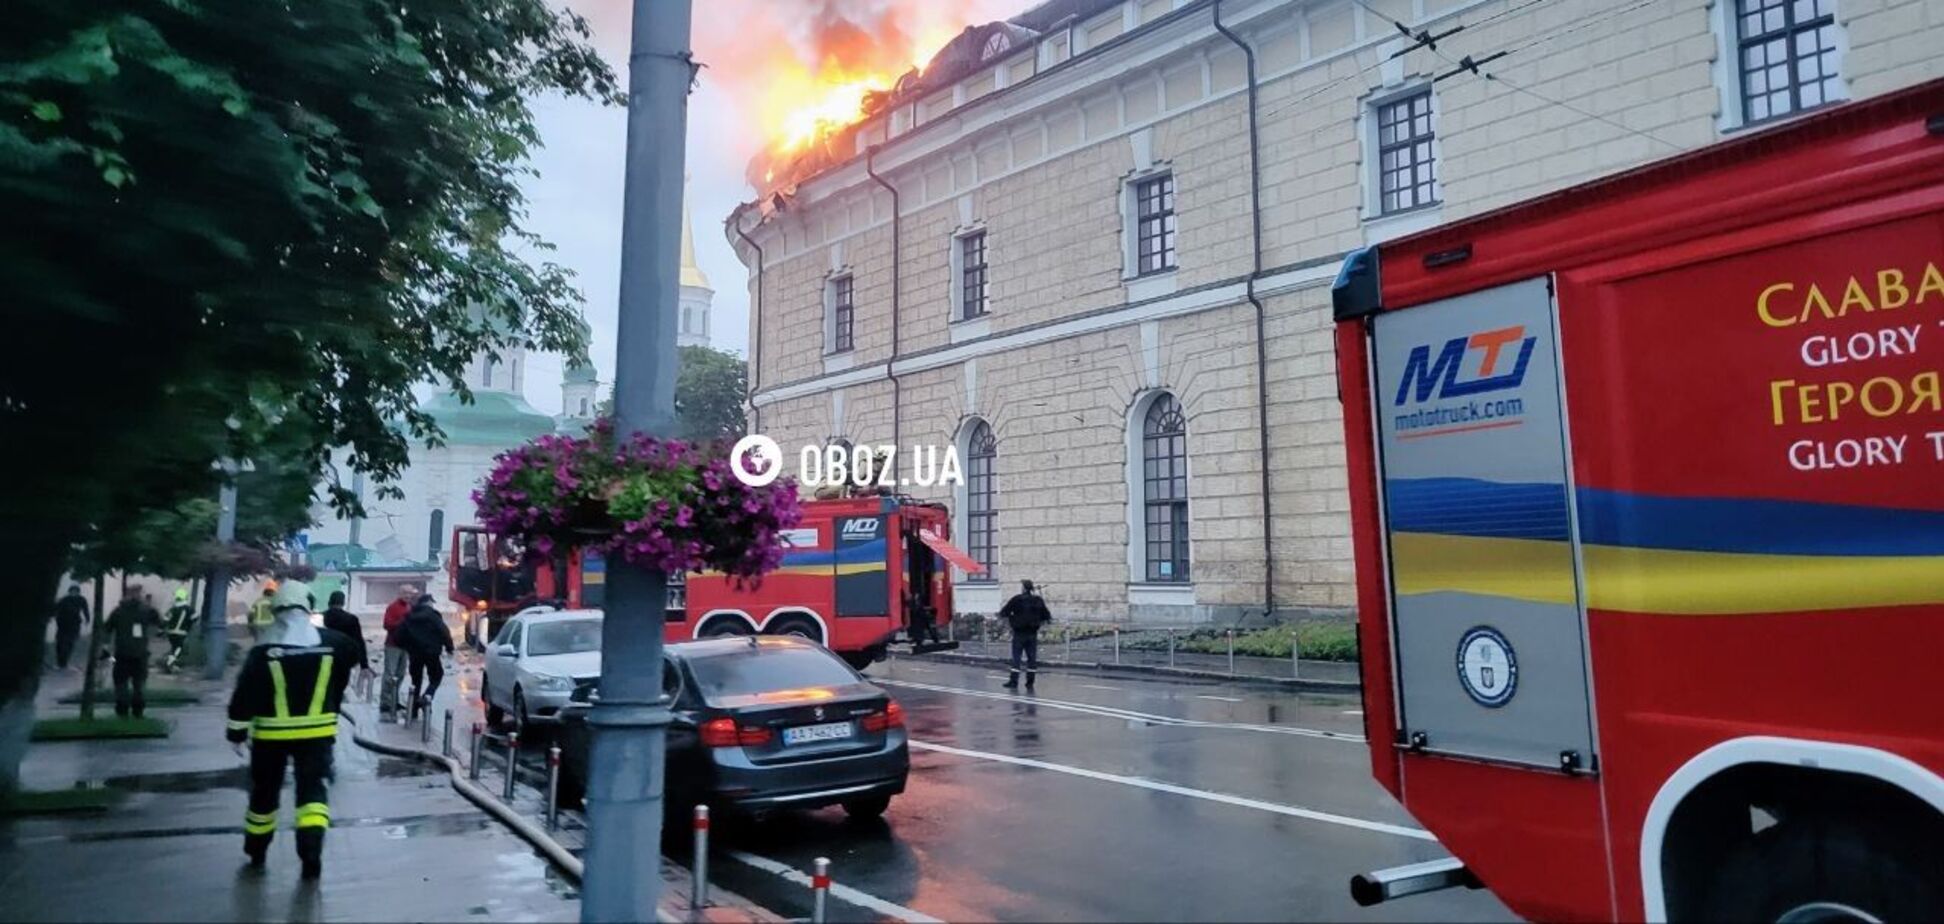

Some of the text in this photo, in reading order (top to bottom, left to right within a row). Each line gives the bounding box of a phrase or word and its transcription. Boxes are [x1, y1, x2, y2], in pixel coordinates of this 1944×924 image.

[1757, 262, 1944, 327] СЛАВА
[1801, 324, 1922, 367] GLORY
[1395, 398, 1523, 431] mototruck.com
[1788, 435, 1908, 470] GLORY
